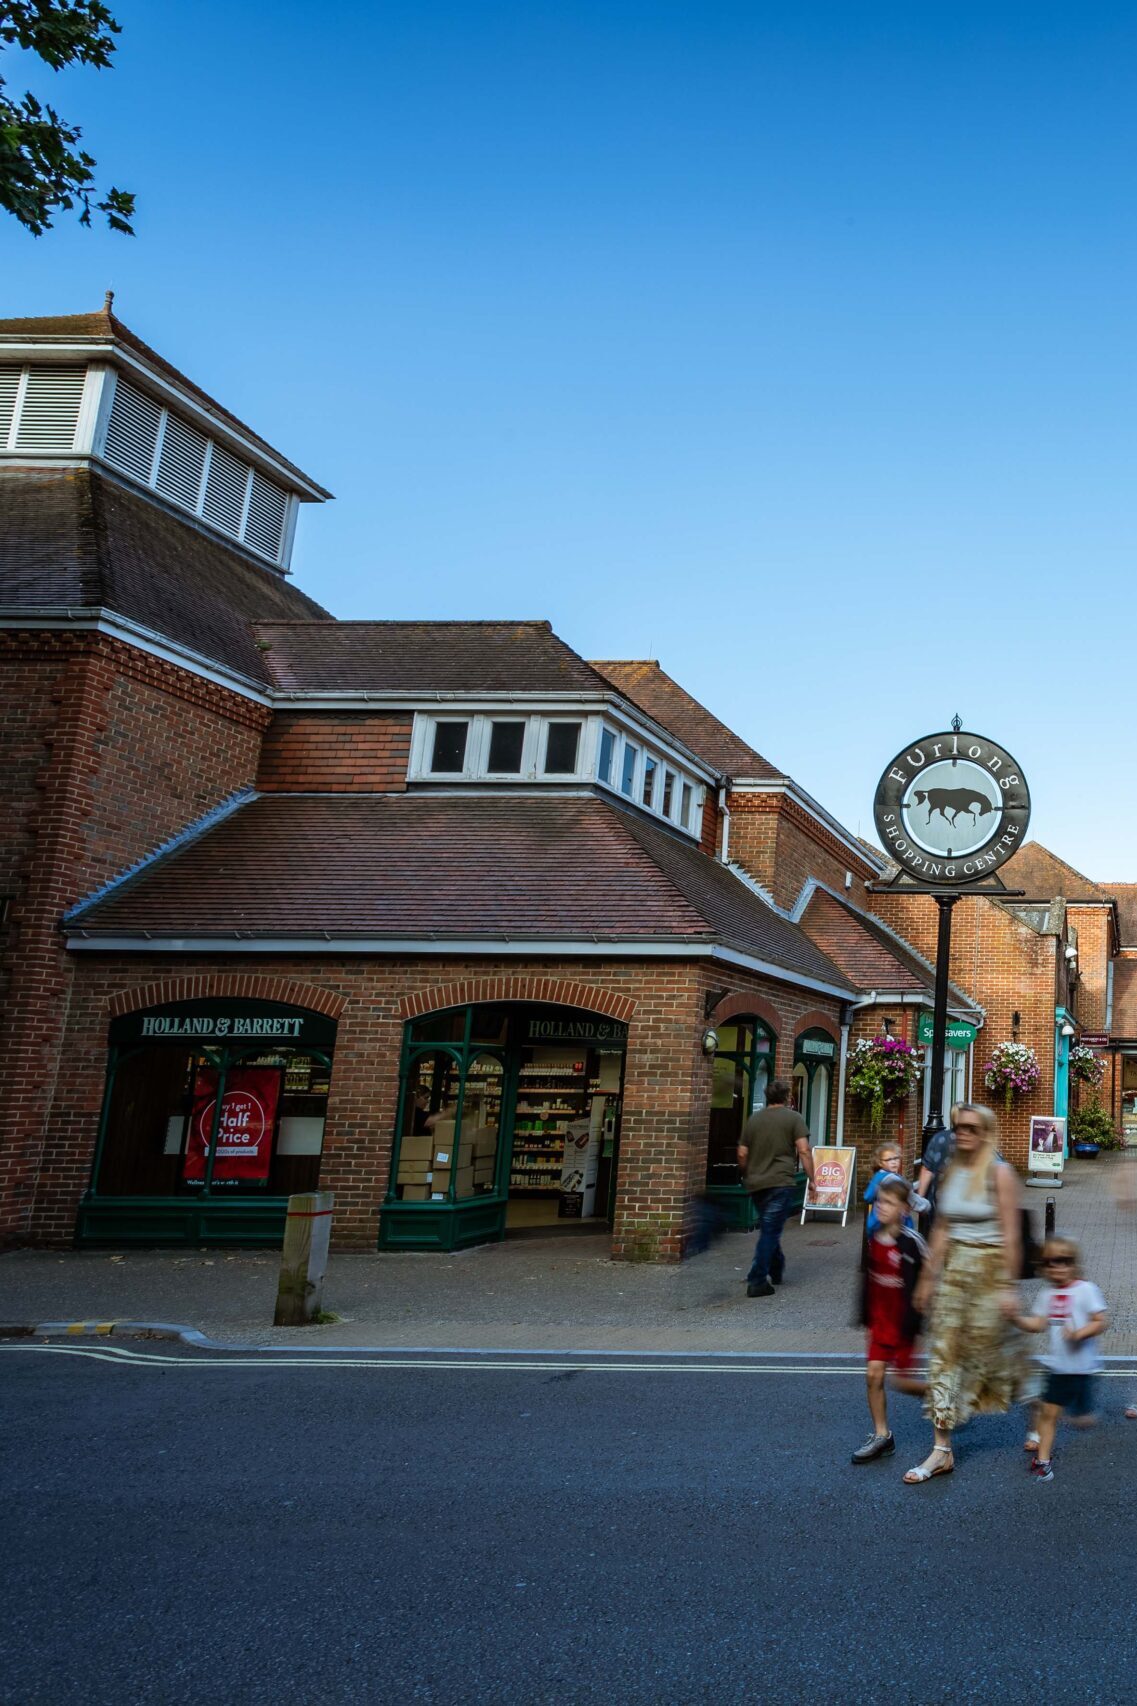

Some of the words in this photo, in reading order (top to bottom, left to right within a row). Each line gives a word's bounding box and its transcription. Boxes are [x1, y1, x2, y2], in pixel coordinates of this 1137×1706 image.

[883, 814, 956, 877] SHOPPING
[963, 824, 1019, 874] CENTRE
[142, 1017, 214, 1036] HOLLAND
[215, 1018, 231, 1037] &
[232, 1018, 304, 1037] BARRETT
[528, 1020, 595, 1038] HOLLAND
[596, 1023, 611, 1040] &
[236, 1103, 247, 1112] get
[821, 1166, 840, 1176] BIG
